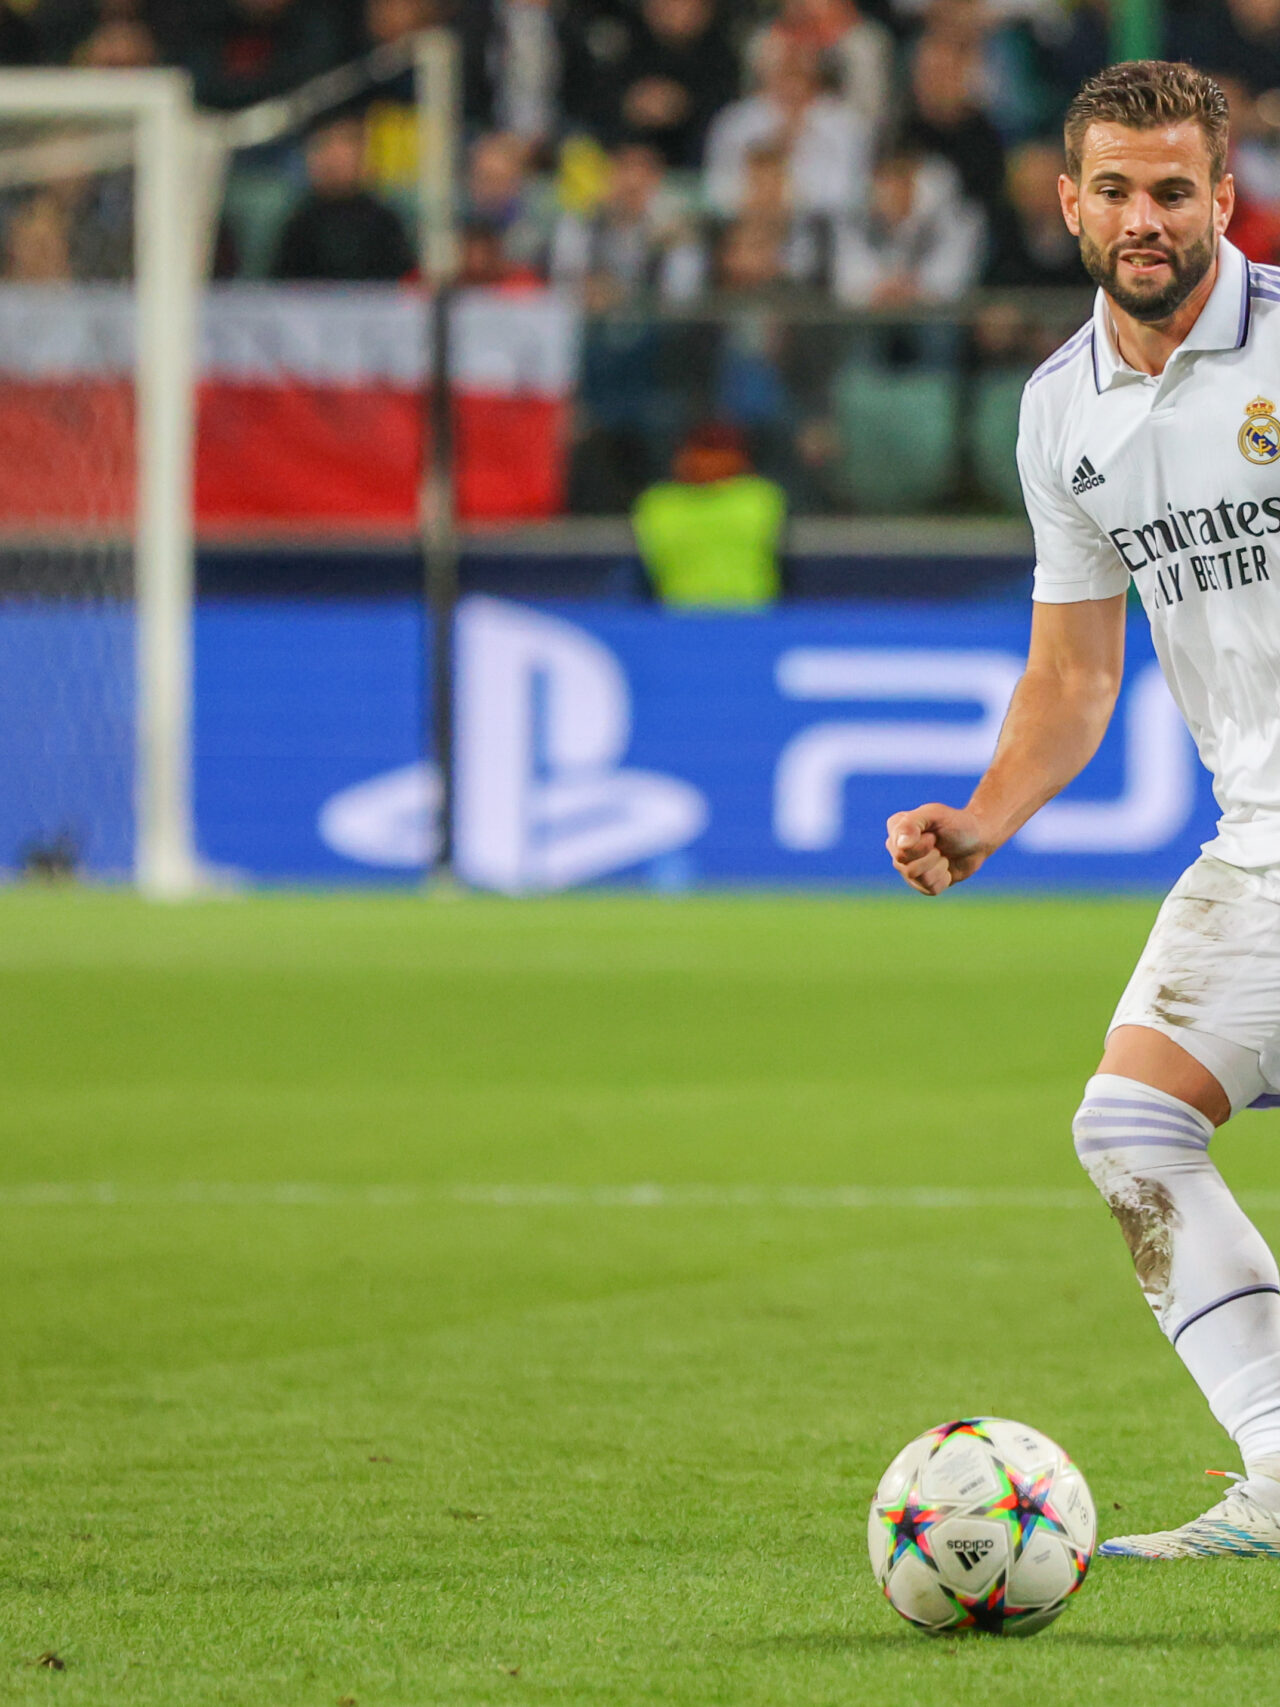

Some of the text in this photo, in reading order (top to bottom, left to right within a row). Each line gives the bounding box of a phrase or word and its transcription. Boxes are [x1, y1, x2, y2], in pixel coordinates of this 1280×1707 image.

[1072, 473, 1106, 495] adidas
[1155, 545, 1270, 609] LY BETTER
[946, 1539, 994, 1551] adidas
